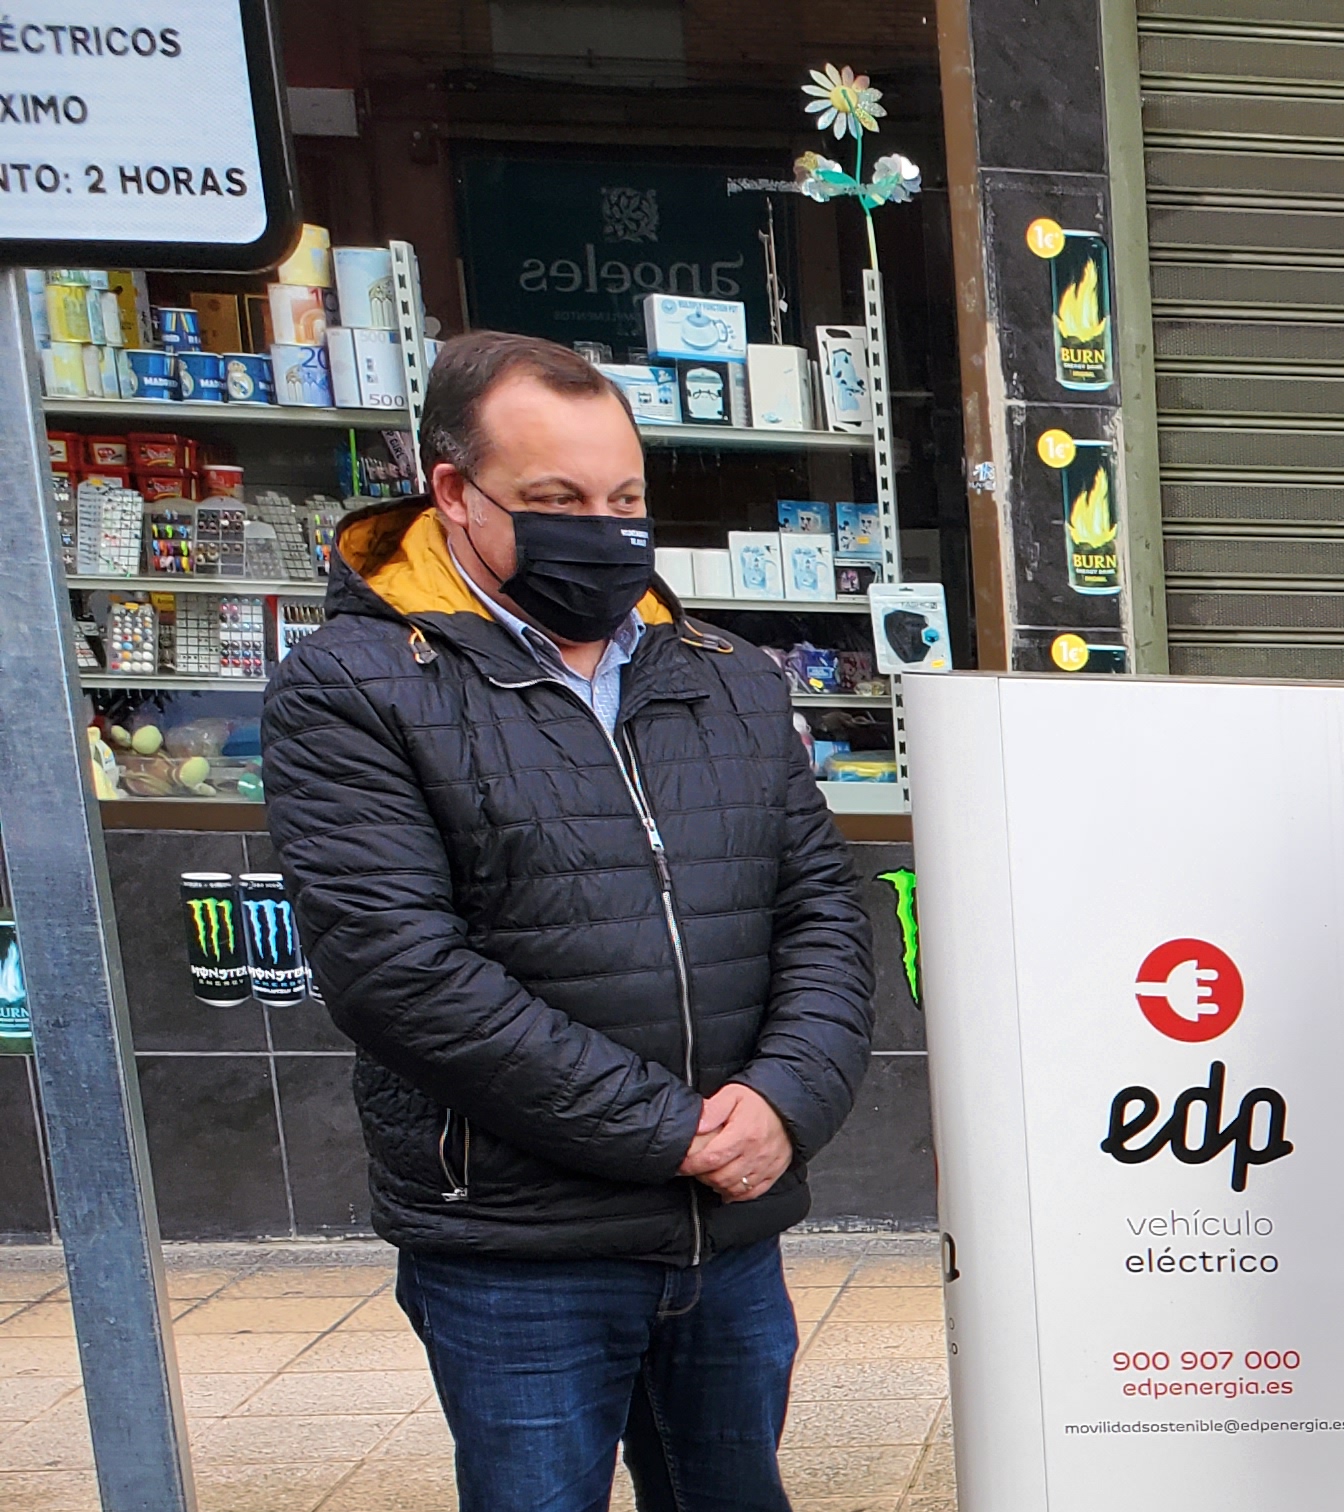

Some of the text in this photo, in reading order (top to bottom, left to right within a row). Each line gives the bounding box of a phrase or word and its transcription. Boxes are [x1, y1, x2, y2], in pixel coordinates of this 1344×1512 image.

[84, 164, 108, 195] 2
[118, 165, 249, 198] HORAS
[1060, 346, 1106, 364] BURN
[1072, 553, 1118, 569] BURN
[0, 1007, 30, 1019] URN
[1101, 1060, 1294, 1192] edp
[1126, 1209, 1273, 1237] vehículo
[1125, 1246, 1279, 1273] eléctrico
[1112, 1350, 1301, 1371] 900 907 000
[1122, 1377, 1294, 1399] edpenergia.es
